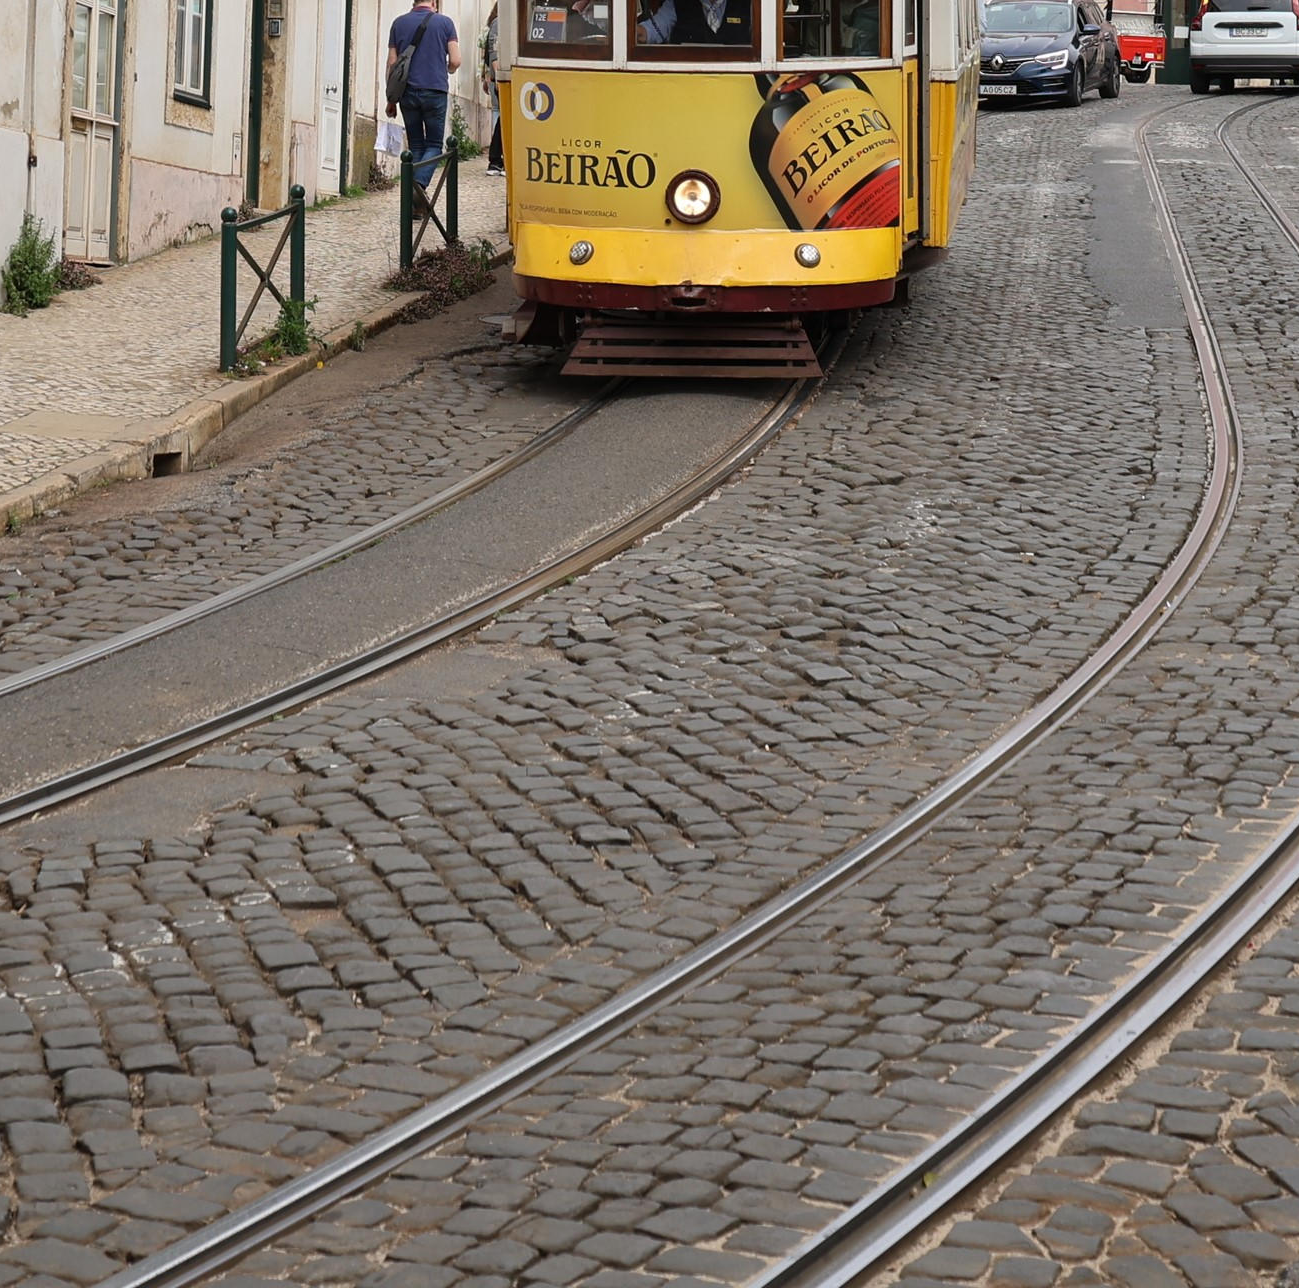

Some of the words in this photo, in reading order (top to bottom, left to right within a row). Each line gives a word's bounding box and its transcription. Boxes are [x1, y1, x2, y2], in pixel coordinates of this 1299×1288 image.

[535, 12, 547, 22] 12E
[532, 27, 545, 39] 02
[811, 108, 850, 134] LICOR
[561, 138, 602, 149] LICOR
[782, 108, 891, 199] BEIRÃO
[525, 146, 656, 189] BEIRÃO
[813, 167, 842, 197] LICOR
[842, 155, 857, 169] DE
[856, 137, 897, 158] PORTUGAL
